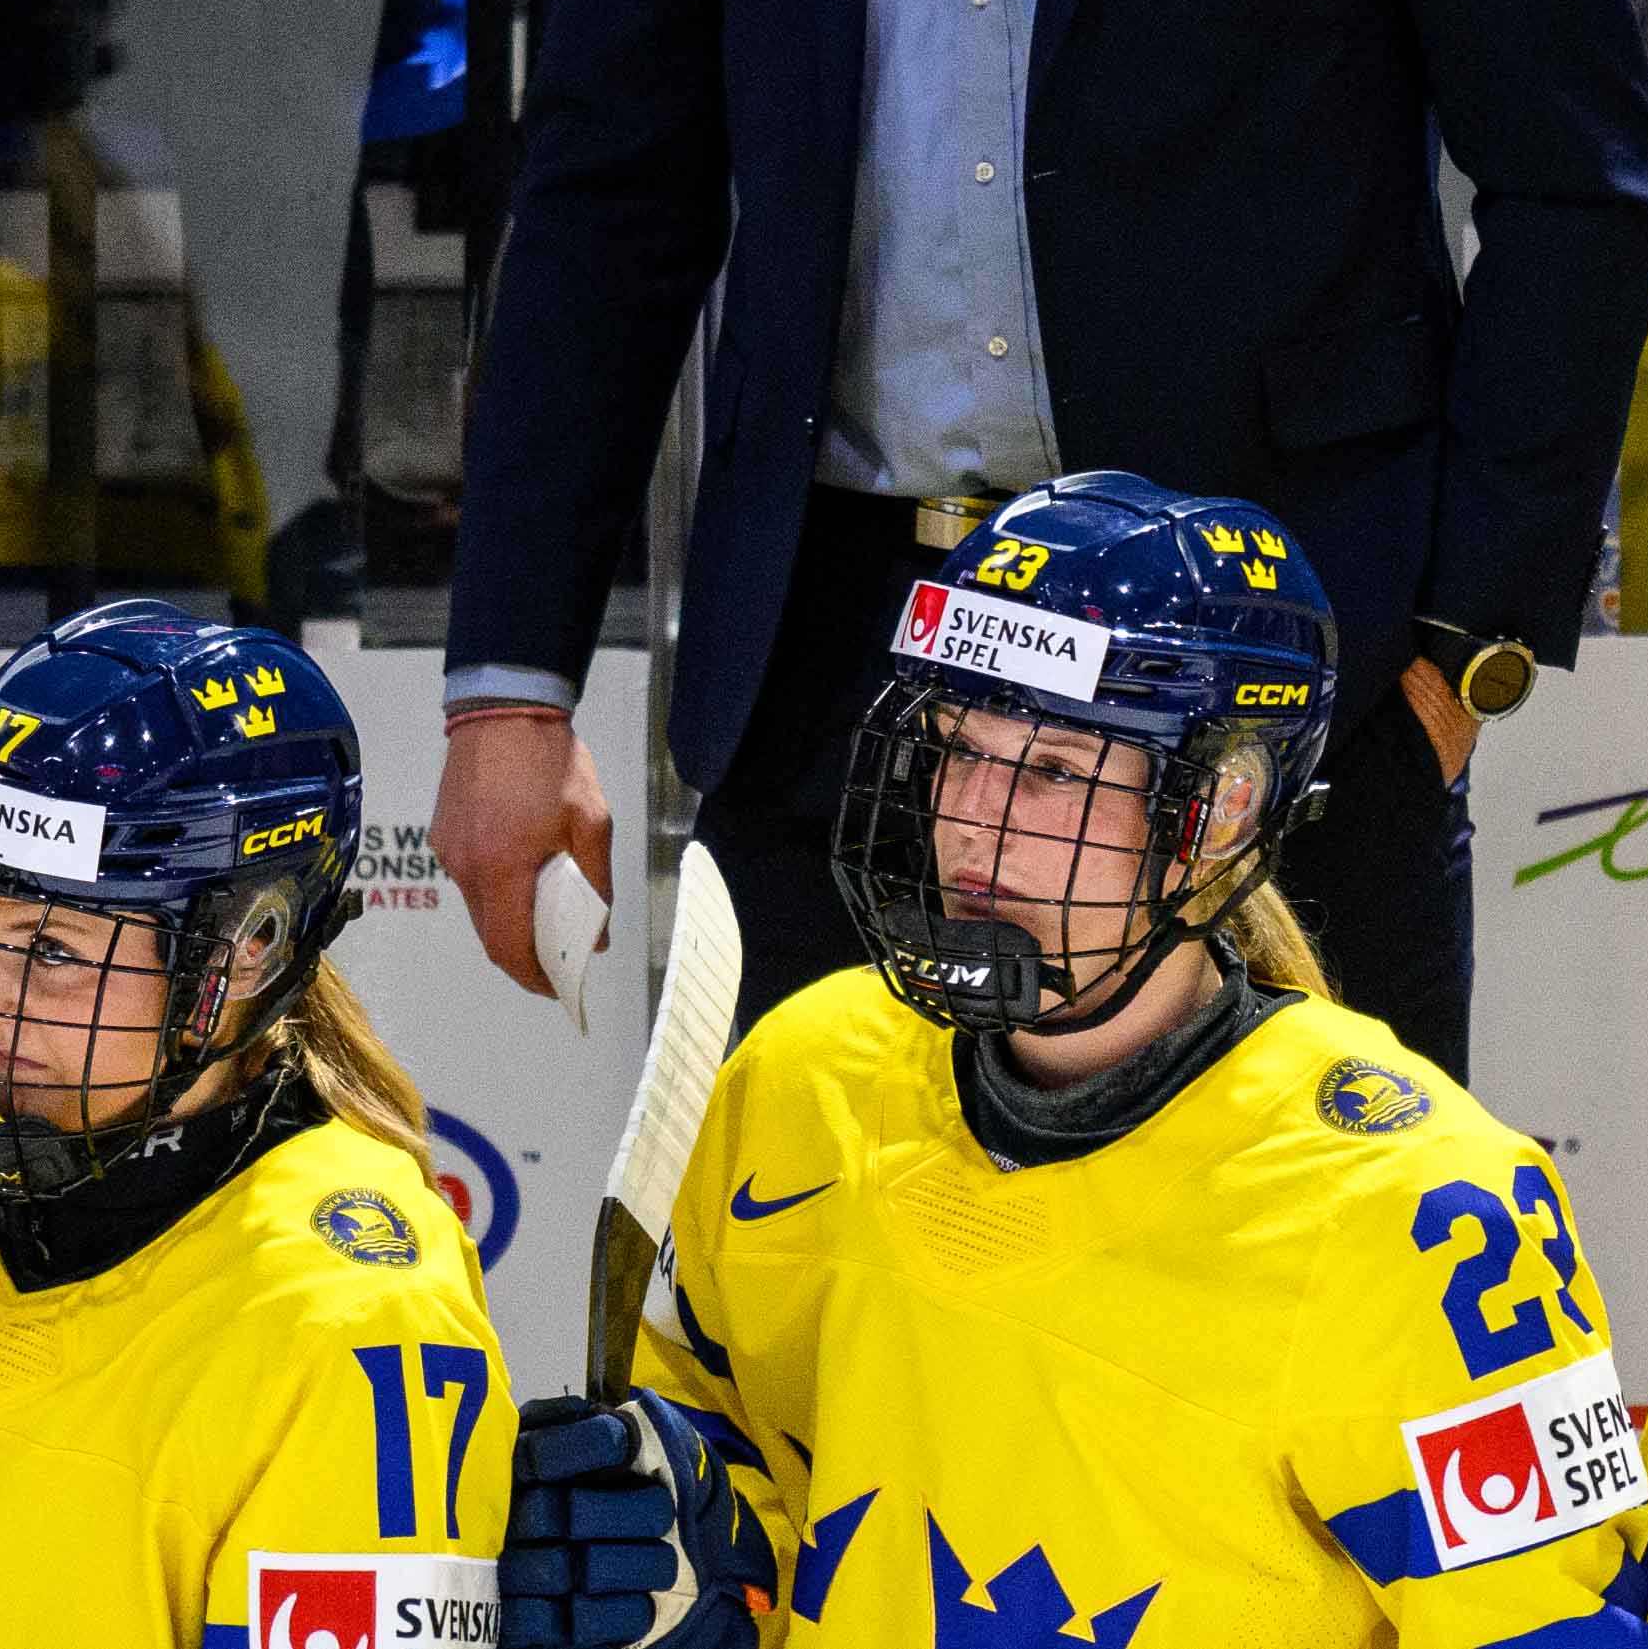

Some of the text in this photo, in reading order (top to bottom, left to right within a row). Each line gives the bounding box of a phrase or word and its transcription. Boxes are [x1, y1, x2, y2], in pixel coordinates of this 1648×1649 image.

[976, 538, 1050, 592] 23
[938, 633, 1003, 674] SPEL
[948, 605, 1079, 664] SVENSKA
[1235, 682, 1311, 707] CCM
[242, 812, 326, 856] CCM
[368, 887, 440, 910] ATES
[352, 1342, 489, 1540] 17
[1548, 1393, 1633, 1459] SVEN
[1564, 1447, 1639, 1508] SPEL
